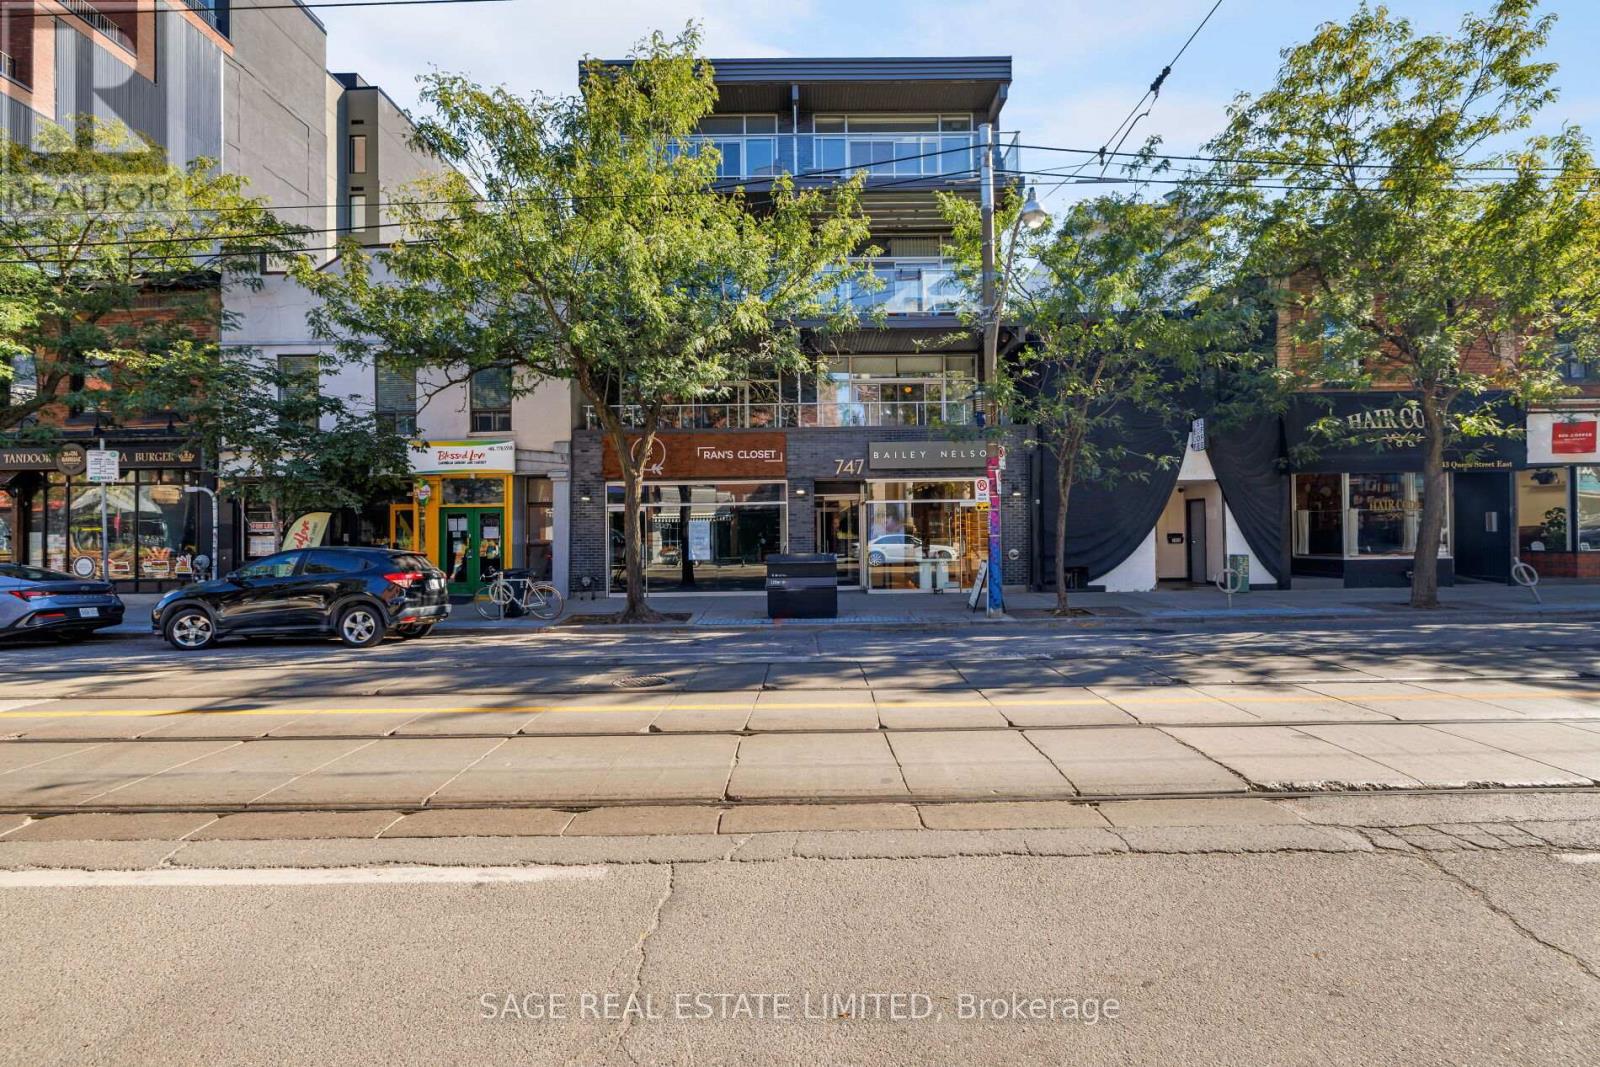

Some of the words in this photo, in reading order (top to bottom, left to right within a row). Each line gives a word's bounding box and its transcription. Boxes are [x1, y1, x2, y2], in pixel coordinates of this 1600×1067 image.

[1346, 408, 1400, 429] HAIR
[135, 452, 175, 462] BURGER
[703, 450, 734, 460] RAN'S
[737, 449, 777, 460] CLOSET
[873, 450, 927, 459] BAILEY
[940, 449, 987, 458] NELSO
[834, 459, 865, 475] 747
[1497, 460, 1513, 468] East
